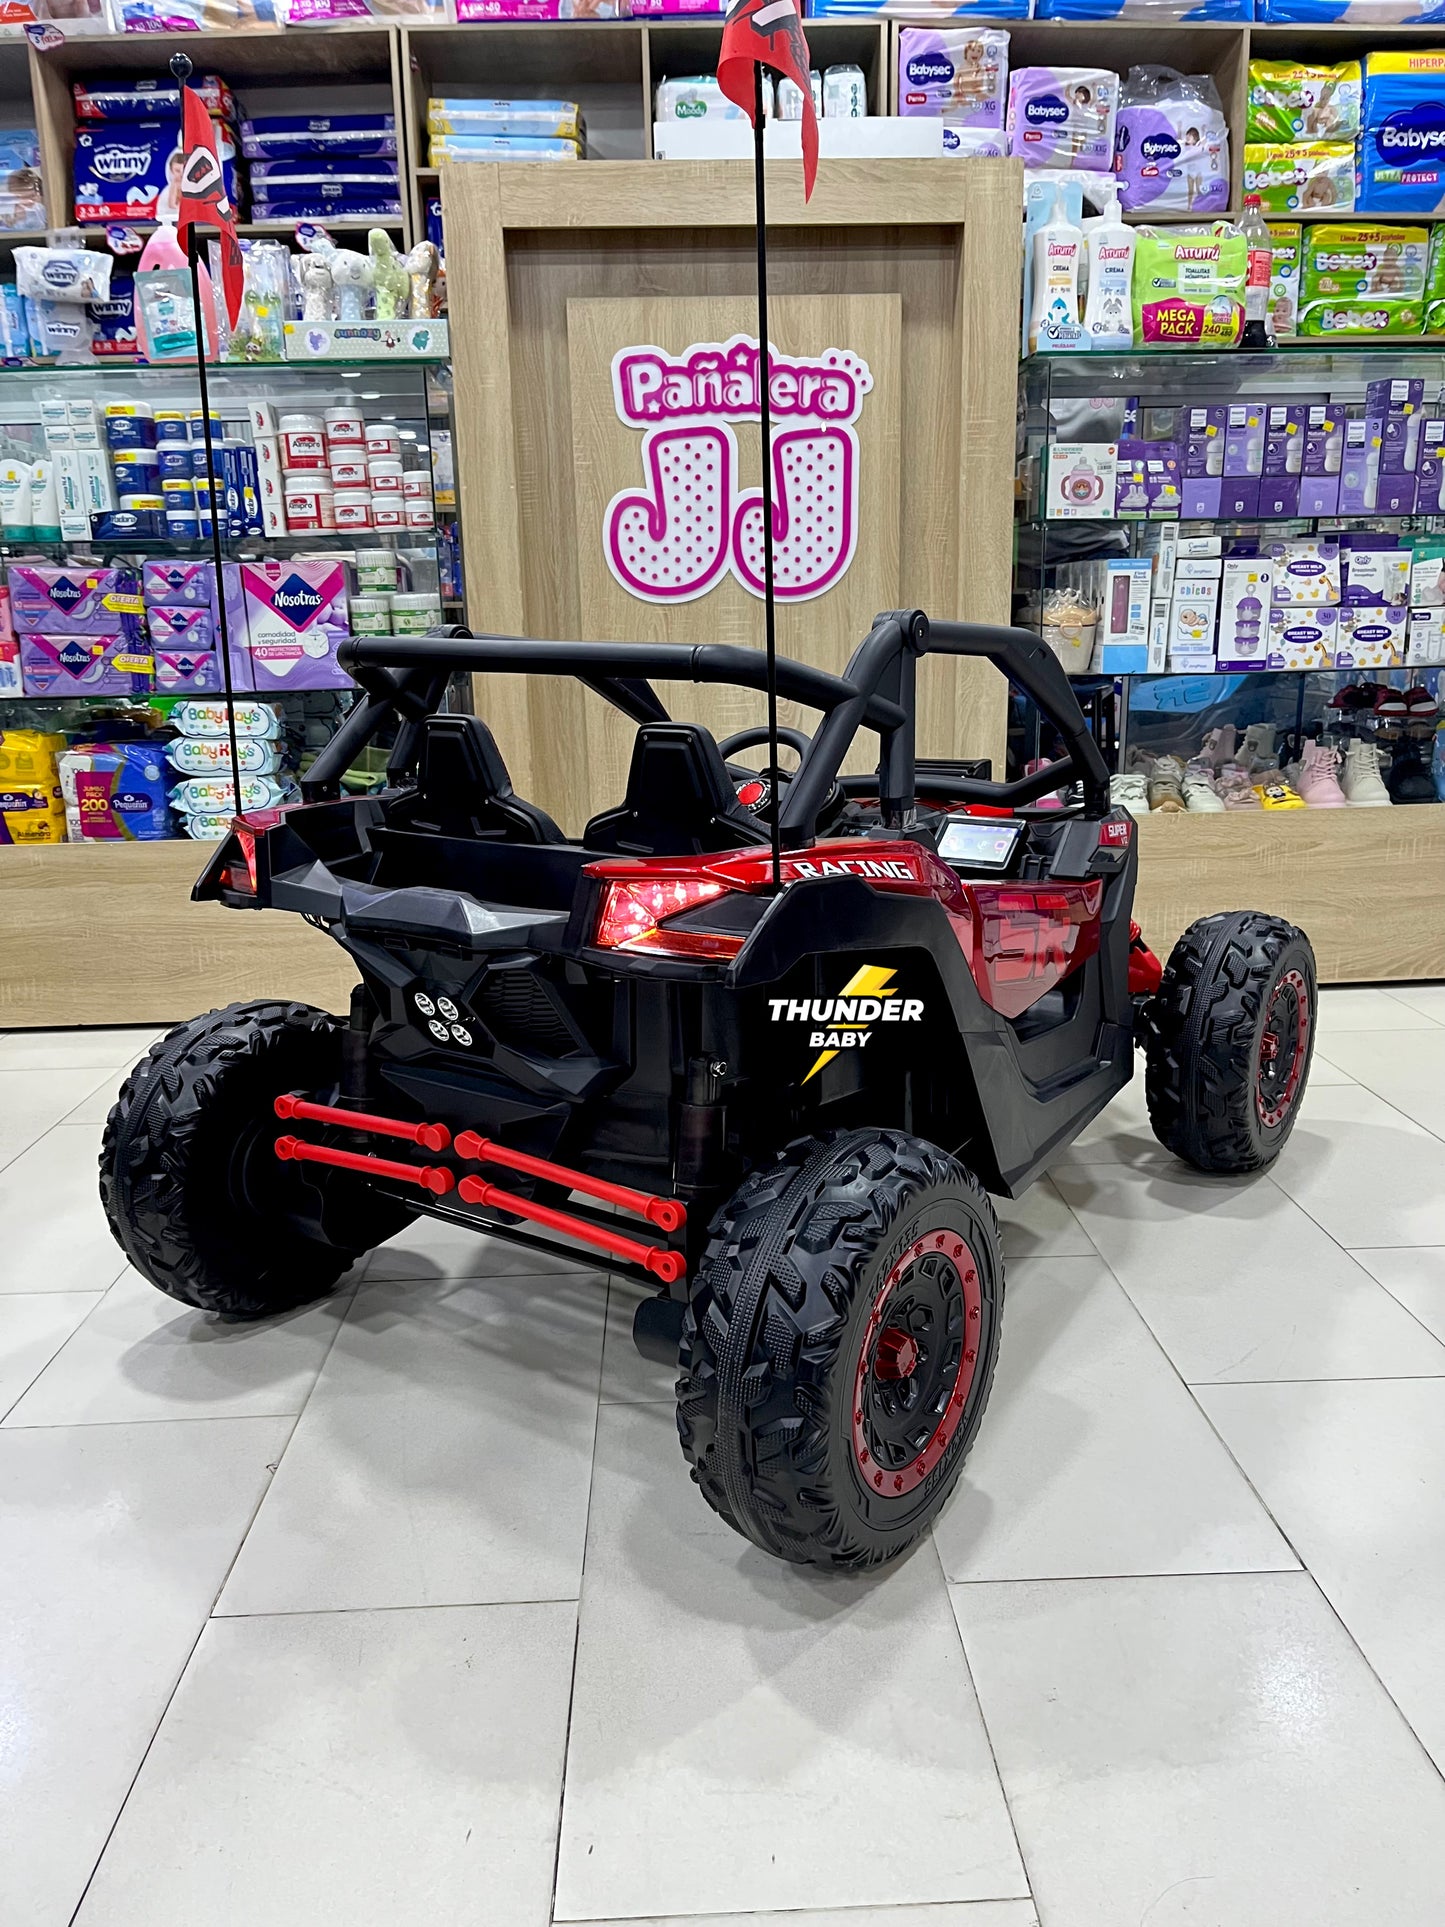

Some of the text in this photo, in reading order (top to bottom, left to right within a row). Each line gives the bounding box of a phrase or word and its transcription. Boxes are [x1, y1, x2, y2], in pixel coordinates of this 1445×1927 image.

[1409, 57, 1445, 68] HIPERP
[909, 63, 951, 77] Babysec
[676, 102, 706, 118] Moody
[984, 101, 996, 110] XG
[1028, 104, 1066, 118] Babysec
[1143, 142, 1179, 155] Babysec
[97, 150, 150, 175] winny
[1374, 170, 1438, 183] ULTRA PROTECT
[1048, 243, 1077, 257] Arrurrú
[1098, 246, 1130, 260] Arrurrú
[1175, 243, 1221, 261] Arrurrú
[45, 268, 78, 286] winny
[92, 301, 132, 317] winny
[1156, 309, 1197, 321] MEGA
[1320, 308, 1389, 330] Bebex
[47, 324, 79, 337] winny
[334, 328, 382, 342] sunnozy
[1160, 322, 1195, 334] PACK
[1203, 324, 1221, 334] 240
[625, 352, 851, 413] Pañalera
[609, 425, 853, 597] JJ
[50, 588, 82, 598] Nosotras
[110, 594, 140, 604] OFERTA
[274, 590, 322, 607] Nosotras
[262, 637, 297, 645] seguridad
[60, 652, 92, 663] Nosotras
[254, 647, 268, 656] 40
[119, 656, 149, 665] OFERTA
[188, 706, 260, 725] Baby ay's
[183, 743, 218, 759] Baby
[190, 783, 225, 800] Baby
[80, 799, 109, 812] 200
[1108, 823, 1128, 837] SUPER
[792, 859, 916, 881] RACING
